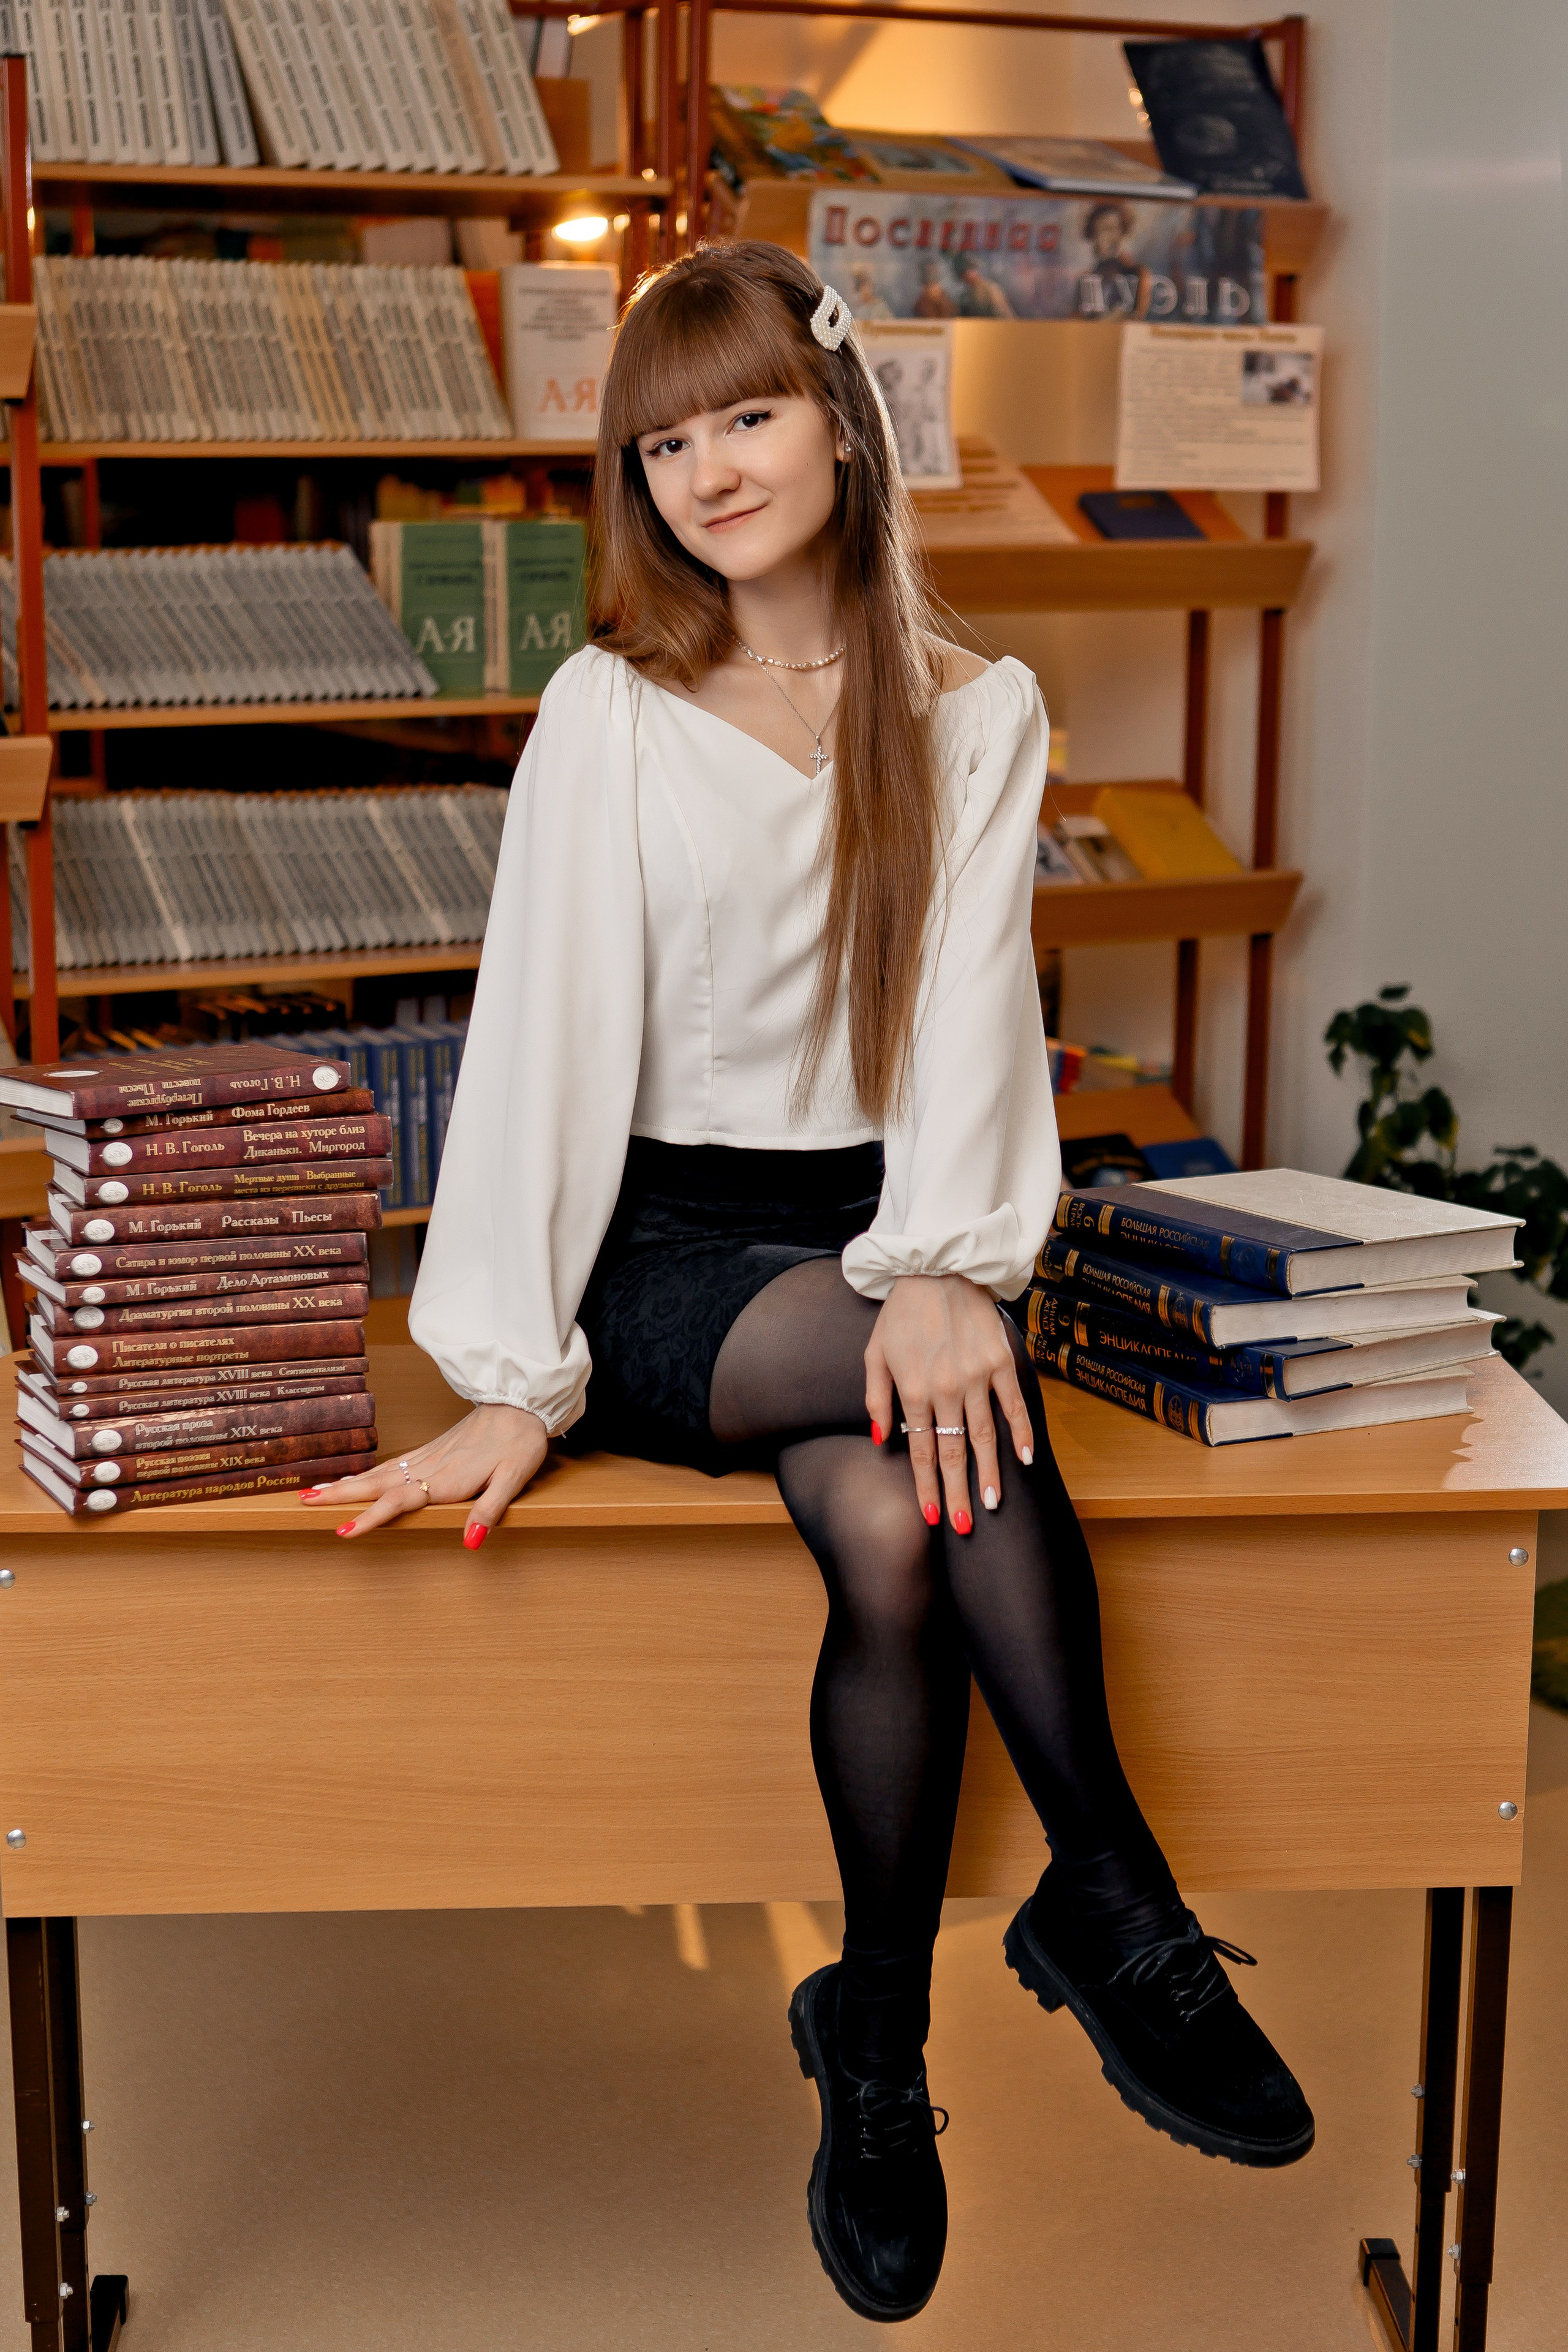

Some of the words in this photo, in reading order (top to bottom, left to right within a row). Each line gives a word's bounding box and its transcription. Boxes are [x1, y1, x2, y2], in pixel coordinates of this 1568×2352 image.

[118, 1083, 155, 1095] Пьесы
[161, 1078, 202, 1089] повести
[229, 1078, 268, 1090] Гоголь
[126, 1092, 203, 1107] Петербургские
[145, 1115, 162, 1127] М.
[165, 1110, 214, 1125] Горький
[231, 1106, 265, 1118] Фома
[266, 1103, 311, 1117] Гордеев
[243, 1129, 283, 1142] Вечера
[285, 1130, 298, 1139] на
[300, 1128, 337, 1140] хуторе
[339, 1125, 366, 1135] близ
[181, 1140, 225, 1153] Гоголь
[243, 1145, 302, 1159] Диканьки.
[309, 1140, 366, 1154] Миргород
[233, 1174, 275, 1185] Мертвые
[276, 1173, 300, 1183] души
[306, 1170, 356, 1181] Выбранные
[179, 1181, 222, 1193] Гоголь
[272, 1183, 316, 1193] переписки
[325, 1182, 364, 1191] друзьями
[128, 1221, 148, 1233] М.
[151, 1218, 202, 1234] Горький
[221, 1215, 279, 1227] Рассказы
[292, 1211, 333, 1224] Пьесы
[1083, 1215, 1095, 1227] 6
[1120, 1216, 1158, 1236] БОЛЬШАЯ
[1158, 1227, 1210, 1250] РОССИЙСКАЯ
[115, 1256, 156, 1269] Сатира
[168, 1256, 198, 1266] юмор
[200, 1250, 237, 1265] первой
[239, 1250, 292, 1260] половины
[318, 1247, 342, 1256] века
[126, 1284, 145, 1297] М.
[146, 1280, 198, 1296] Горький
[216, 1276, 247, 1291] Дело
[249, 1271, 330, 1287] Артамоновых
[1082, 1263, 1111, 1283] БОЛЬШАЯ
[1112, 1275, 1152, 1298] РОССИЙСКАЯ
[118, 1308, 193, 1322] Драматургия
[195, 1302, 233, 1317] второй
[236, 1302, 290, 1313] половины
[318, 1298, 343, 1308] века
[1058, 1314, 1071, 1327] 9
[111, 1340, 168, 1354] Писатели
[179, 1338, 235, 1349] писателях
[112, 1355, 194, 1368] Литературные
[195, 1351, 249, 1363] портреты
[1046, 1349, 1056, 1363] 5
[119, 1378, 160, 1390] Русская
[162, 1374, 216, 1385] литература
[217, 1368, 249, 1381] XVIII
[278, 1365, 346, 1376] Сентиментализм
[1076, 1354, 1106, 1376] БОЛЬШАЯ
[1106, 1367, 1146, 1394] РОССИЙСКАЯ
[119, 1400, 159, 1412] Русская
[160, 1395, 215, 1407] литература
[216, 1389, 248, 1402] XVIII
[249, 1390, 271, 1398] века
[277, 1385, 325, 1395] Классицизм
[1075, 1368, 1147, 1412] ЭНЦИКЛОПЕДИЯ
[134, 1422, 180, 1437] Русская
[182, 1419, 214, 1431] проза
[134, 1436, 173, 1450] второй
[175, 1433, 228, 1446] половины
[230, 1425, 258, 1438] XIX
[259, 1425, 283, 1435] века
[136, 1457, 177, 1469] Русская
[177, 1453, 211, 1463] поэзия
[136, 1465, 171, 1479] первой
[172, 1461, 219, 1474] половины
[219, 1455, 244, 1468] XIX
[244, 1456, 266, 1465] века
[130, 1487, 203, 1503] Литература
[205, 1481, 255, 1494] народов
[256, 1475, 301, 1488] России
